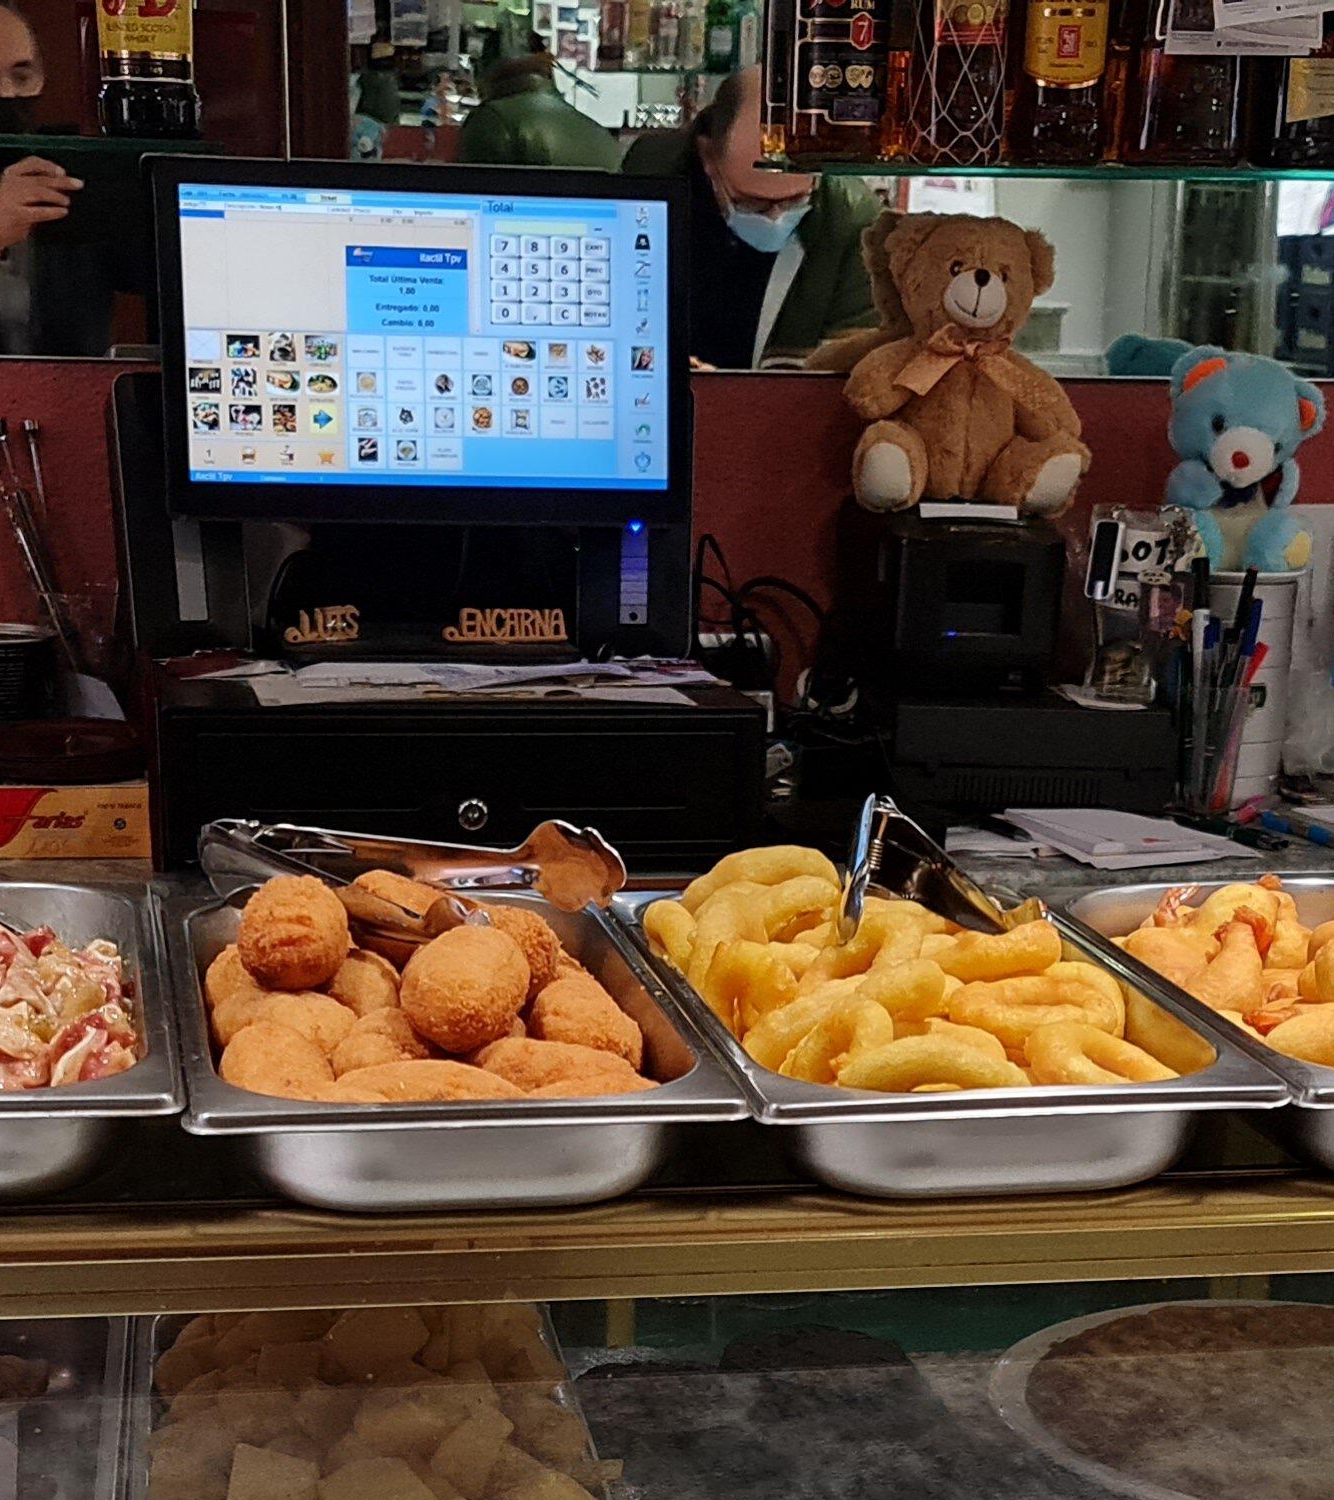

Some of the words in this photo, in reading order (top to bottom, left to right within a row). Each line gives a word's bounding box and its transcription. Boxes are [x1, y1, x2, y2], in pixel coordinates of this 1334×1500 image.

[858, 22, 869, 42] 7
[487, 200, 515, 213] Total
[501, 241, 509, 252] 7
[530, 242, 539, 252] 8
[560, 243, 569, 253] 9
[501, 263, 509, 273] 4
[530, 264, 539, 274] 5
[560, 265, 569, 275] 6
[531, 286, 539, 297] 2
[560, 287, 569, 297] 3
[501, 307, 510, 318] 0
[560, 308, 570, 320] C
[460, 607, 569, 641] ENCARNA
